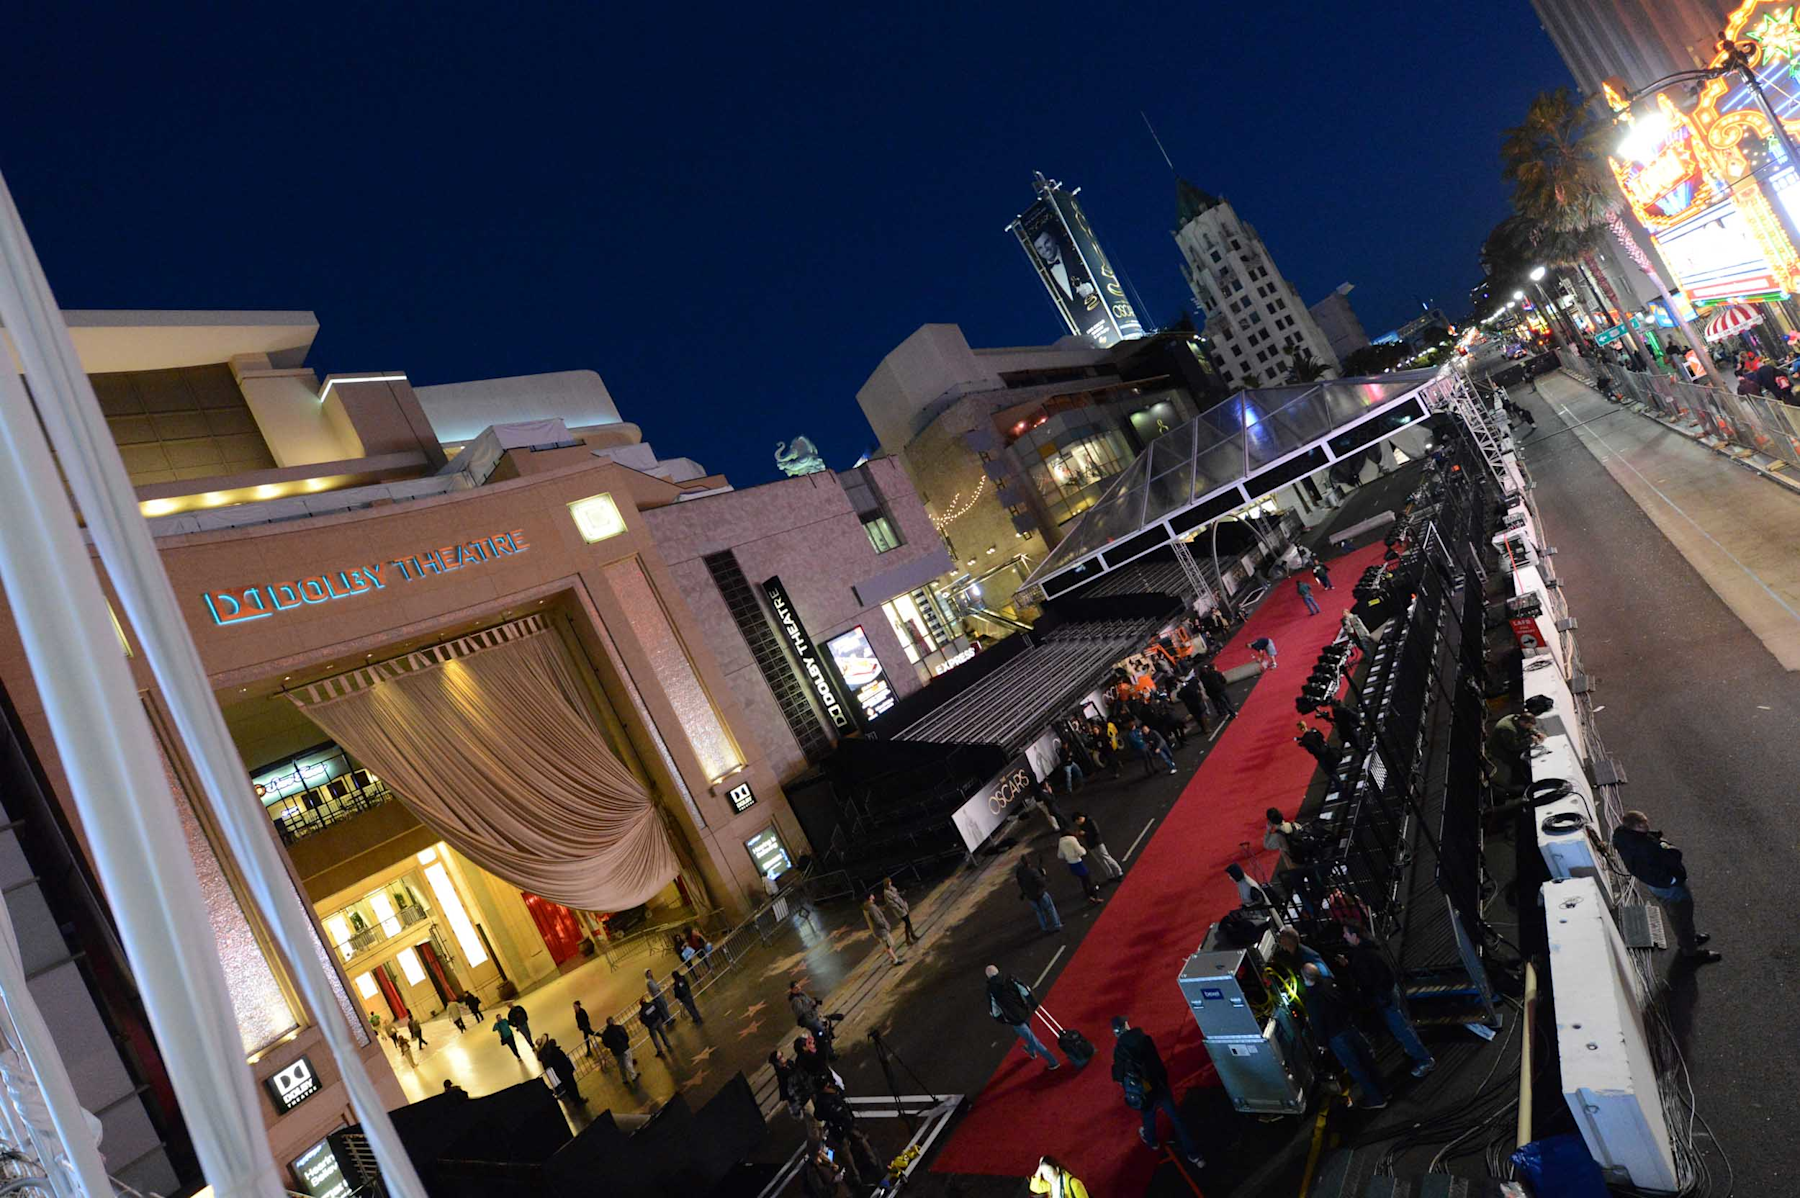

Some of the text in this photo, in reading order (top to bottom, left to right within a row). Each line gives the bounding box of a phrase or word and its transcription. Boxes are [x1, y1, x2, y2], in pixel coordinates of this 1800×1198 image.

[266, 529, 530, 611] DOLBY THEATRE
[769, 587, 836, 707] DOLBY THEATRE
[935, 647, 976, 675] EXPRESS
[988, 769, 1030, 815] OSCARS
[282, 1077, 314, 1104] DOLBY
[287, 1086, 318, 1108] THEATRE
